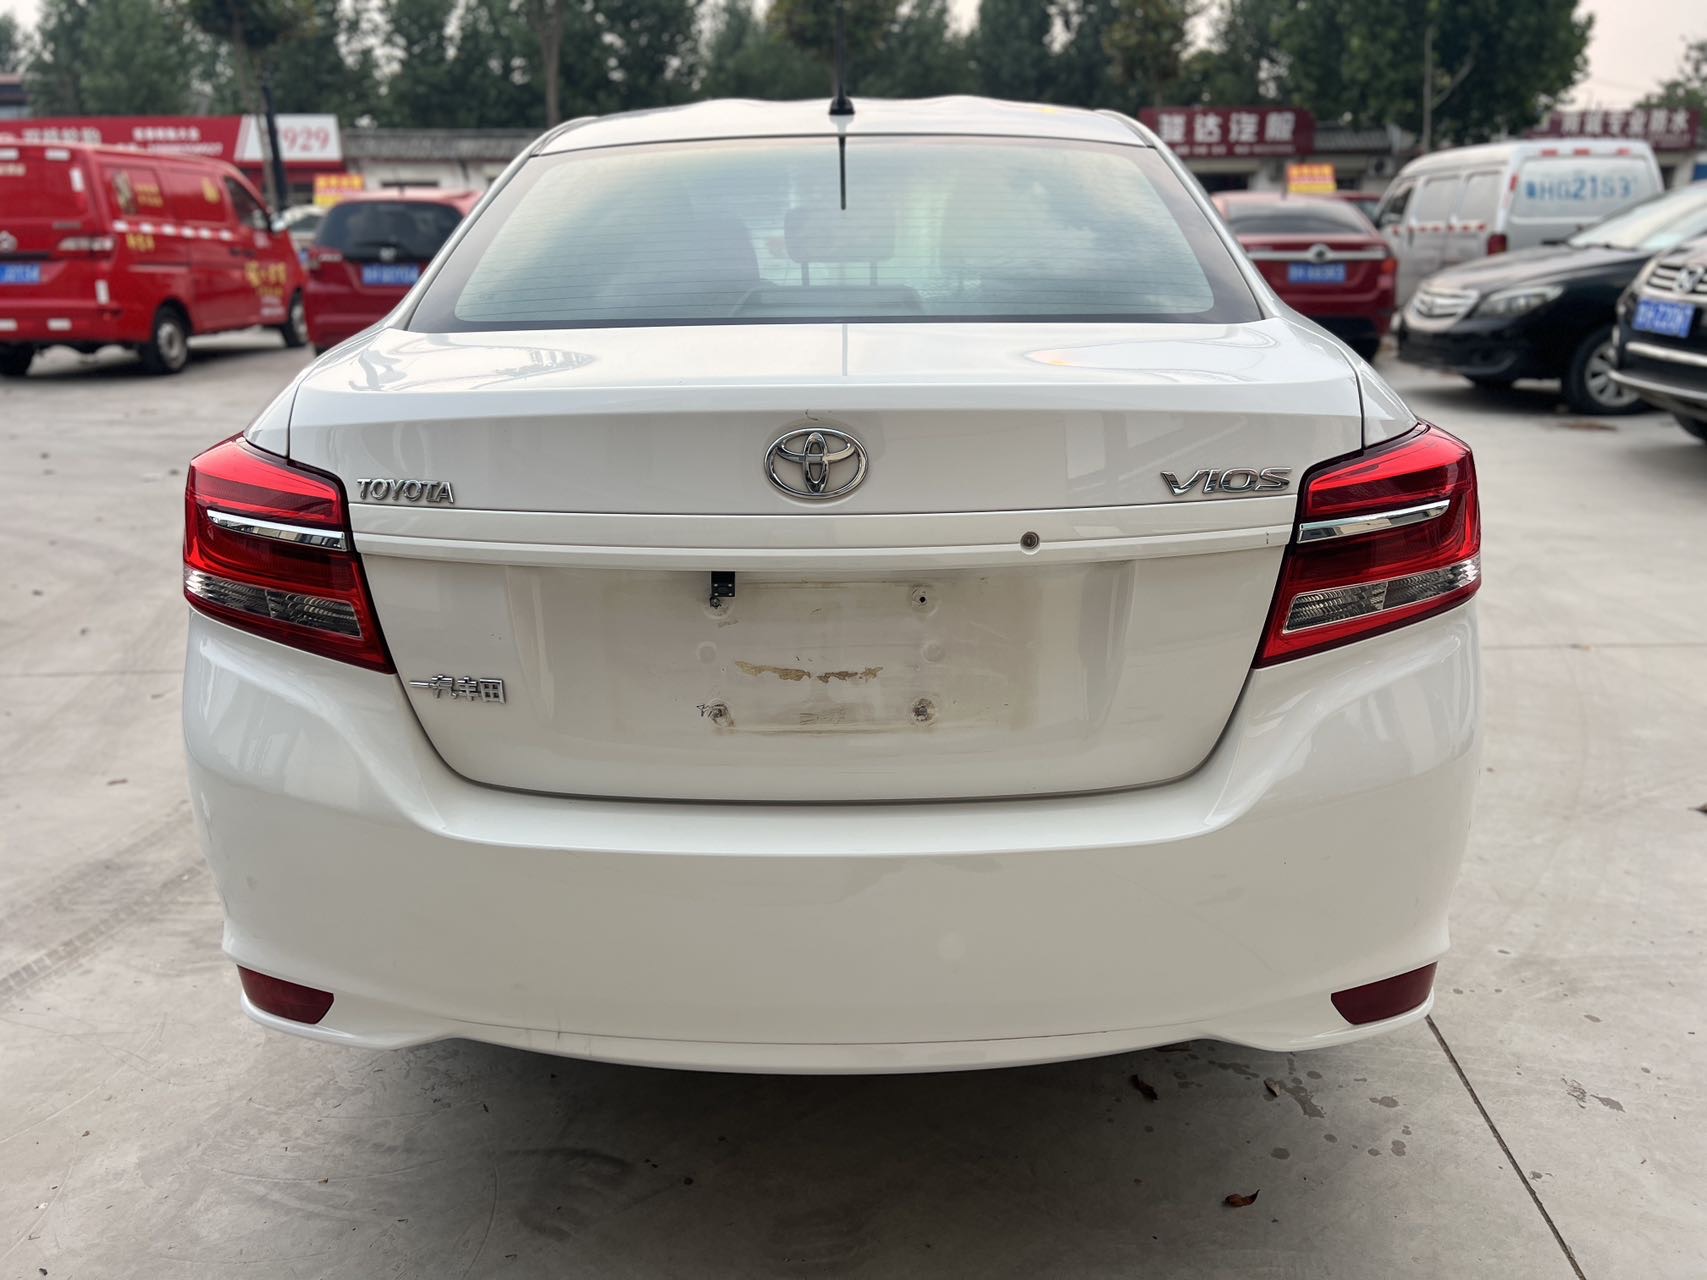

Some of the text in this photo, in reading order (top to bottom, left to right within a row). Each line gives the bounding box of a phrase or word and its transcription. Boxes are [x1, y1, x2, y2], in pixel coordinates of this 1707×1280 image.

[357, 478, 455, 504] TOYOTA
[1160, 467, 1293, 497] VIOS
[409, 674, 506, 704] 一汽丰田
